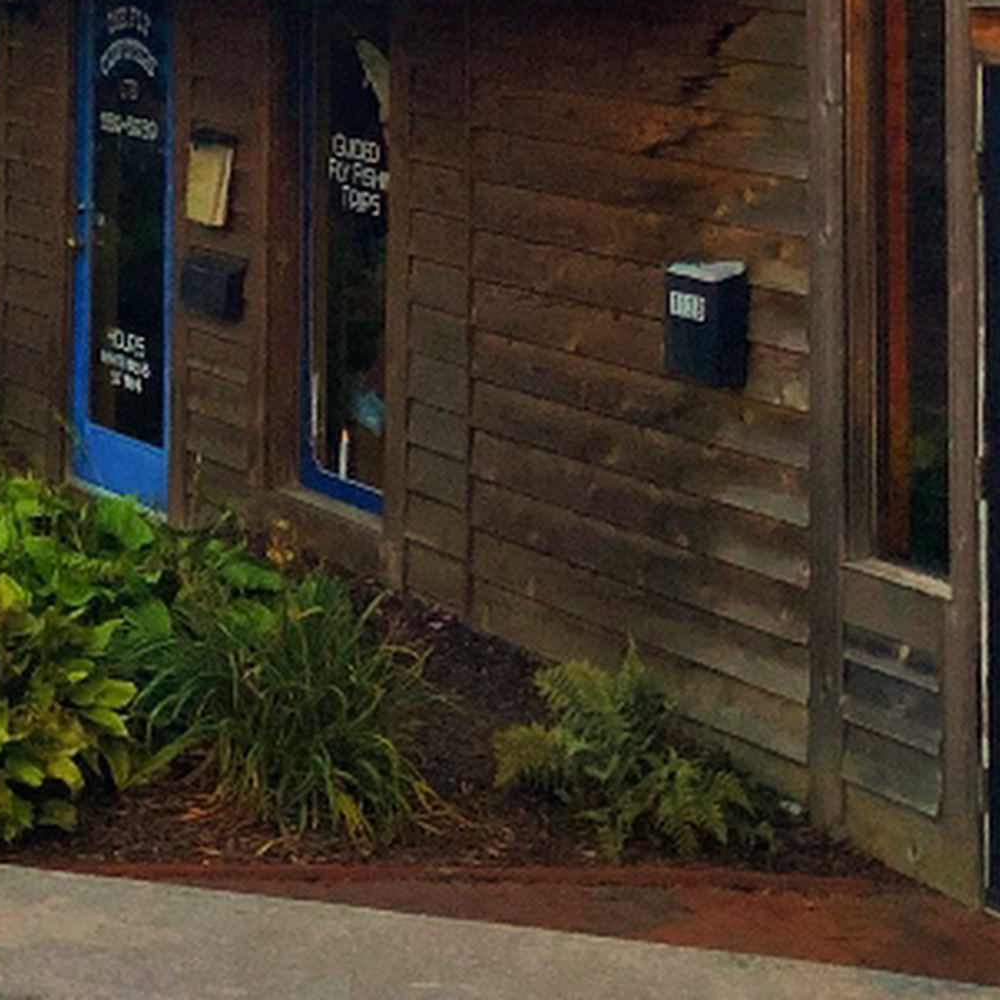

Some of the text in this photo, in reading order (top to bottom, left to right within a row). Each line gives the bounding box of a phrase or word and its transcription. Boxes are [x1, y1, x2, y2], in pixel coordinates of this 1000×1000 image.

[332, 132, 380, 163] GUIDED
[328, 157, 351, 182] FLY
[342, 184, 380, 216] TRIPS
